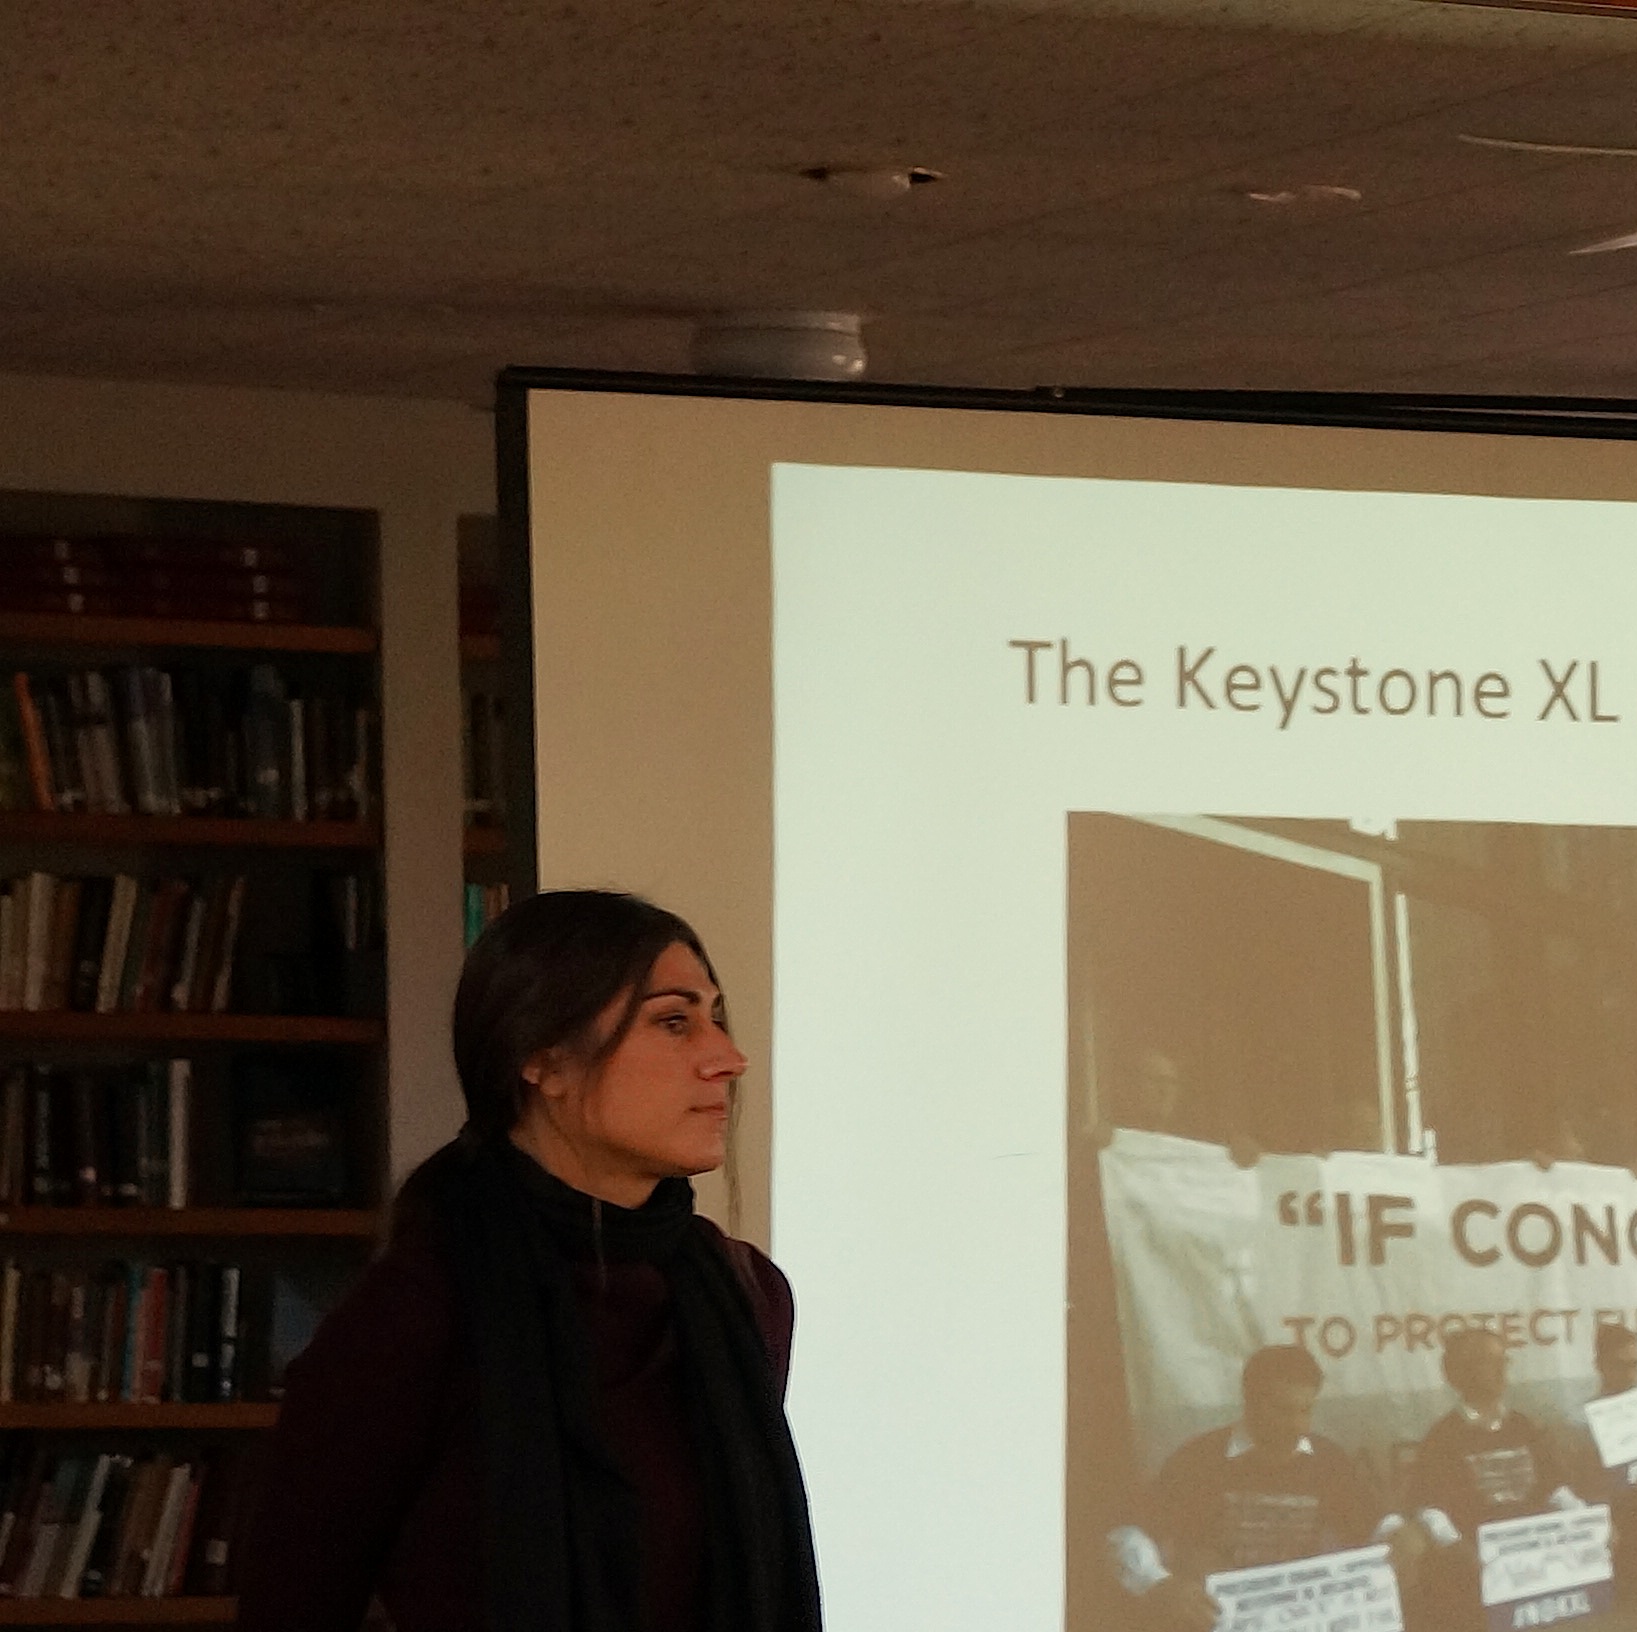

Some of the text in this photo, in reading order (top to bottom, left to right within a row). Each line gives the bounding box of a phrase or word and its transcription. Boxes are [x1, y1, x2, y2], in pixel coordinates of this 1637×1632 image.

[1008, 637, 1144, 707] The
[1177, 645, 1512, 730] Keystone
[1537, 659, 1621, 722] XL
[1283, 1316, 1357, 1358] TO
